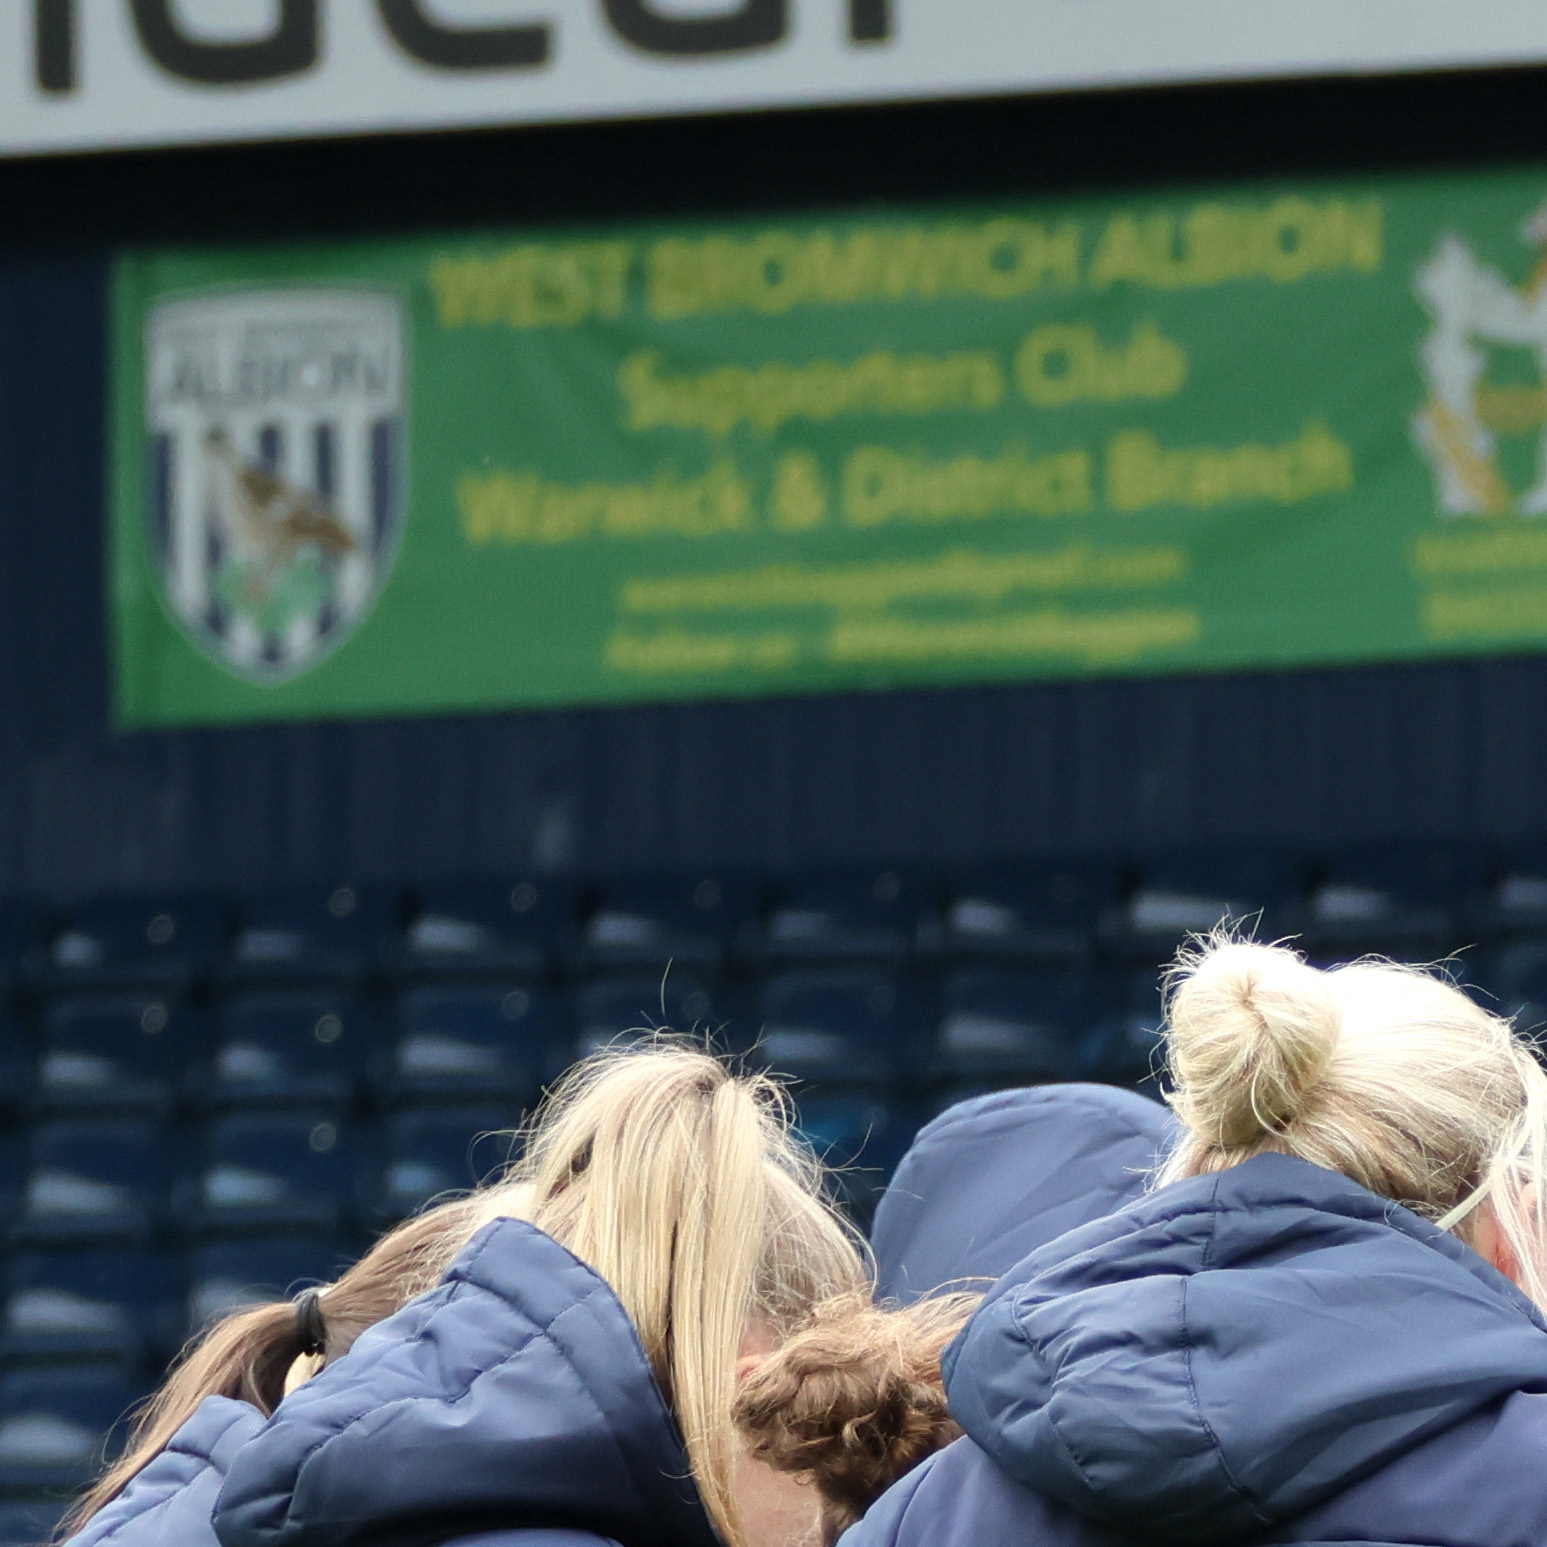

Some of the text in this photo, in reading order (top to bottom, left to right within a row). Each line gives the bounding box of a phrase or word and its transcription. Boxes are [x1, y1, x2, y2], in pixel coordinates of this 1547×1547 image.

[430, 195, 1385, 330] WEST BROMWICH ALBION
[619, 319, 1188, 435] Supporters Club
[456, 421, 1354, 546] Warwick & District Branch
